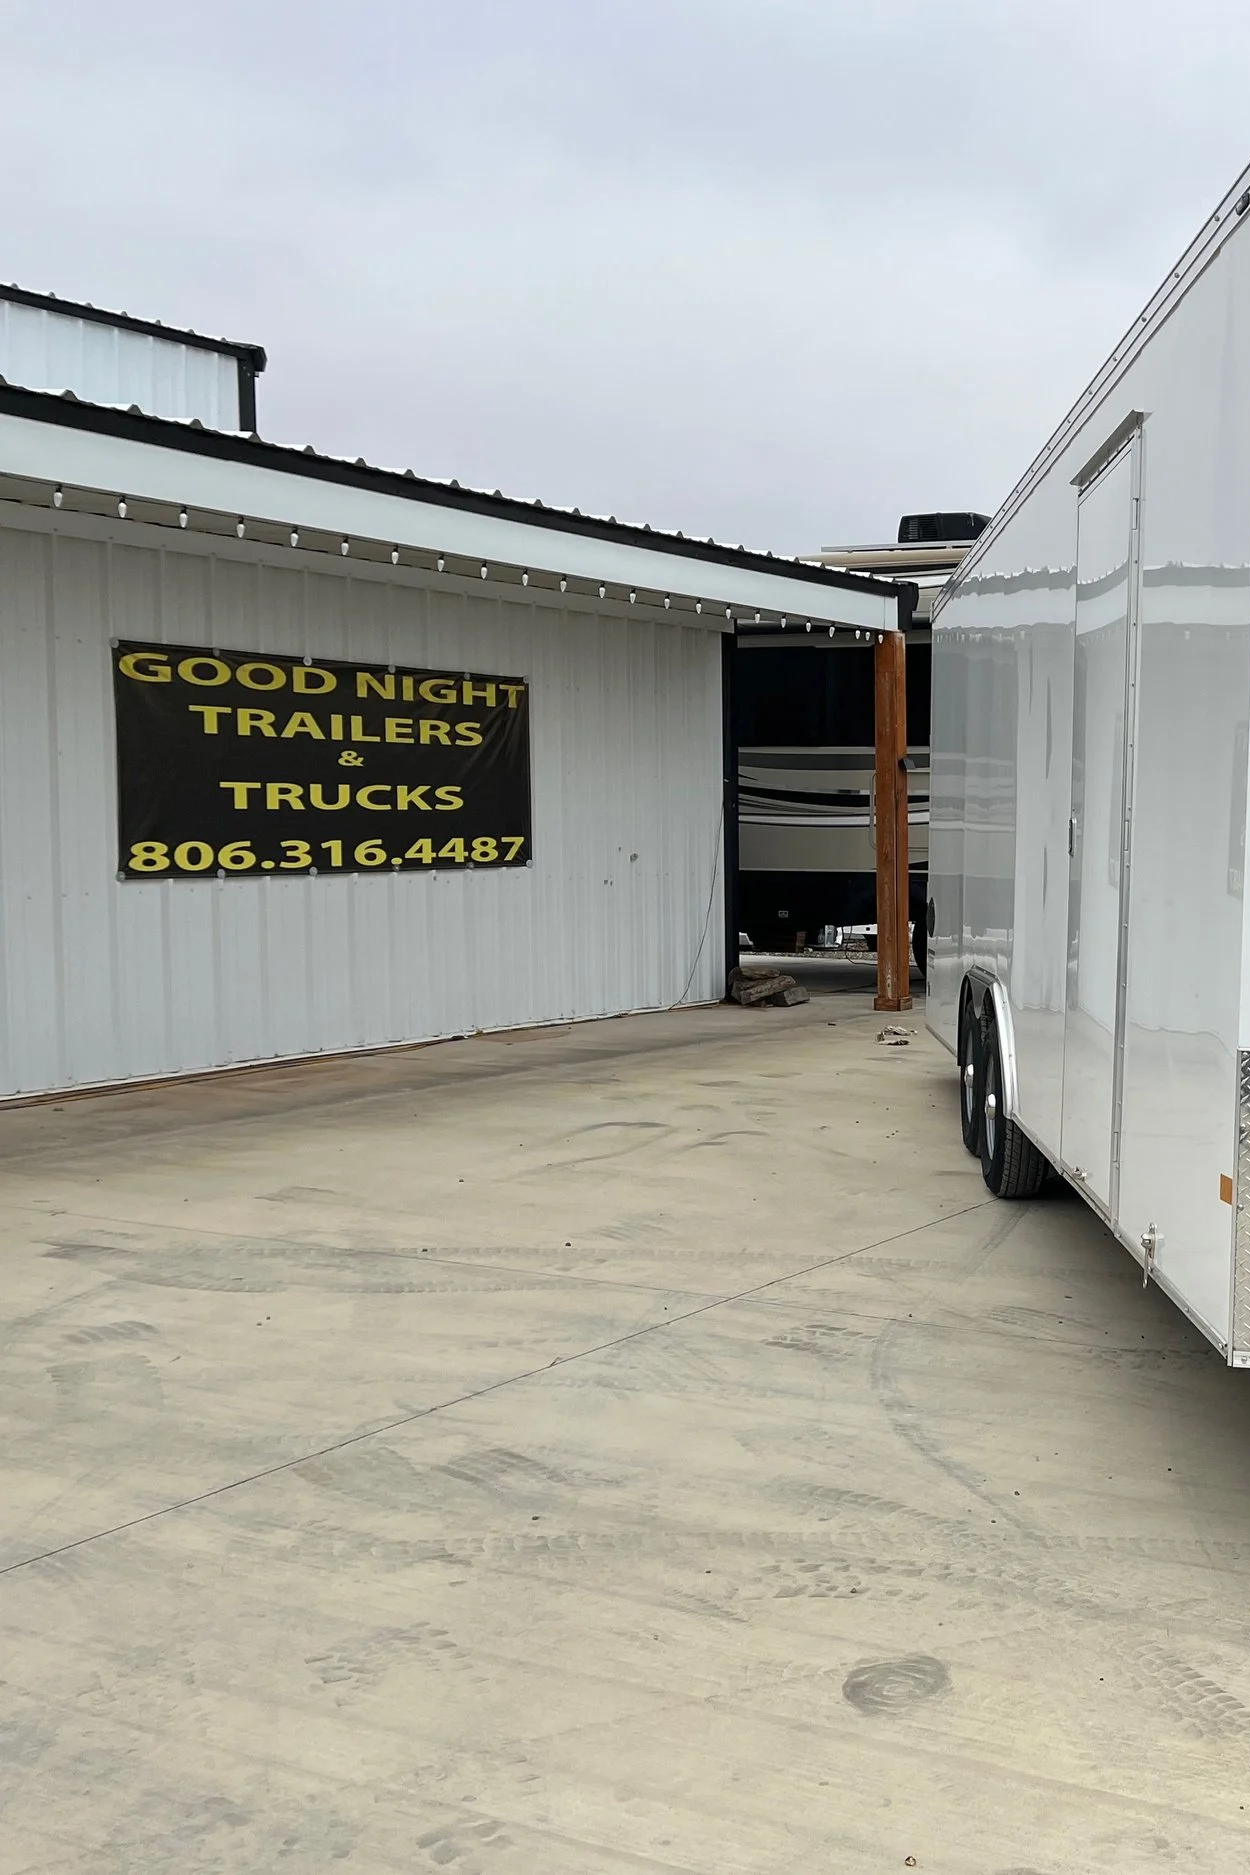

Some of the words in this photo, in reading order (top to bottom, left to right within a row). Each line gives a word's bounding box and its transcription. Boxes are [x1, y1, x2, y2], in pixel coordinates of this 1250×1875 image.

[118, 652, 337, 695] GOOD
[356, 671, 525, 709] NIGHT
[188, 704, 484, 747] TRAILERS
[338, 750, 364, 767] &
[219, 781, 465, 811] TRUCKS
[127, 836, 525, 872] 806.316.4487
